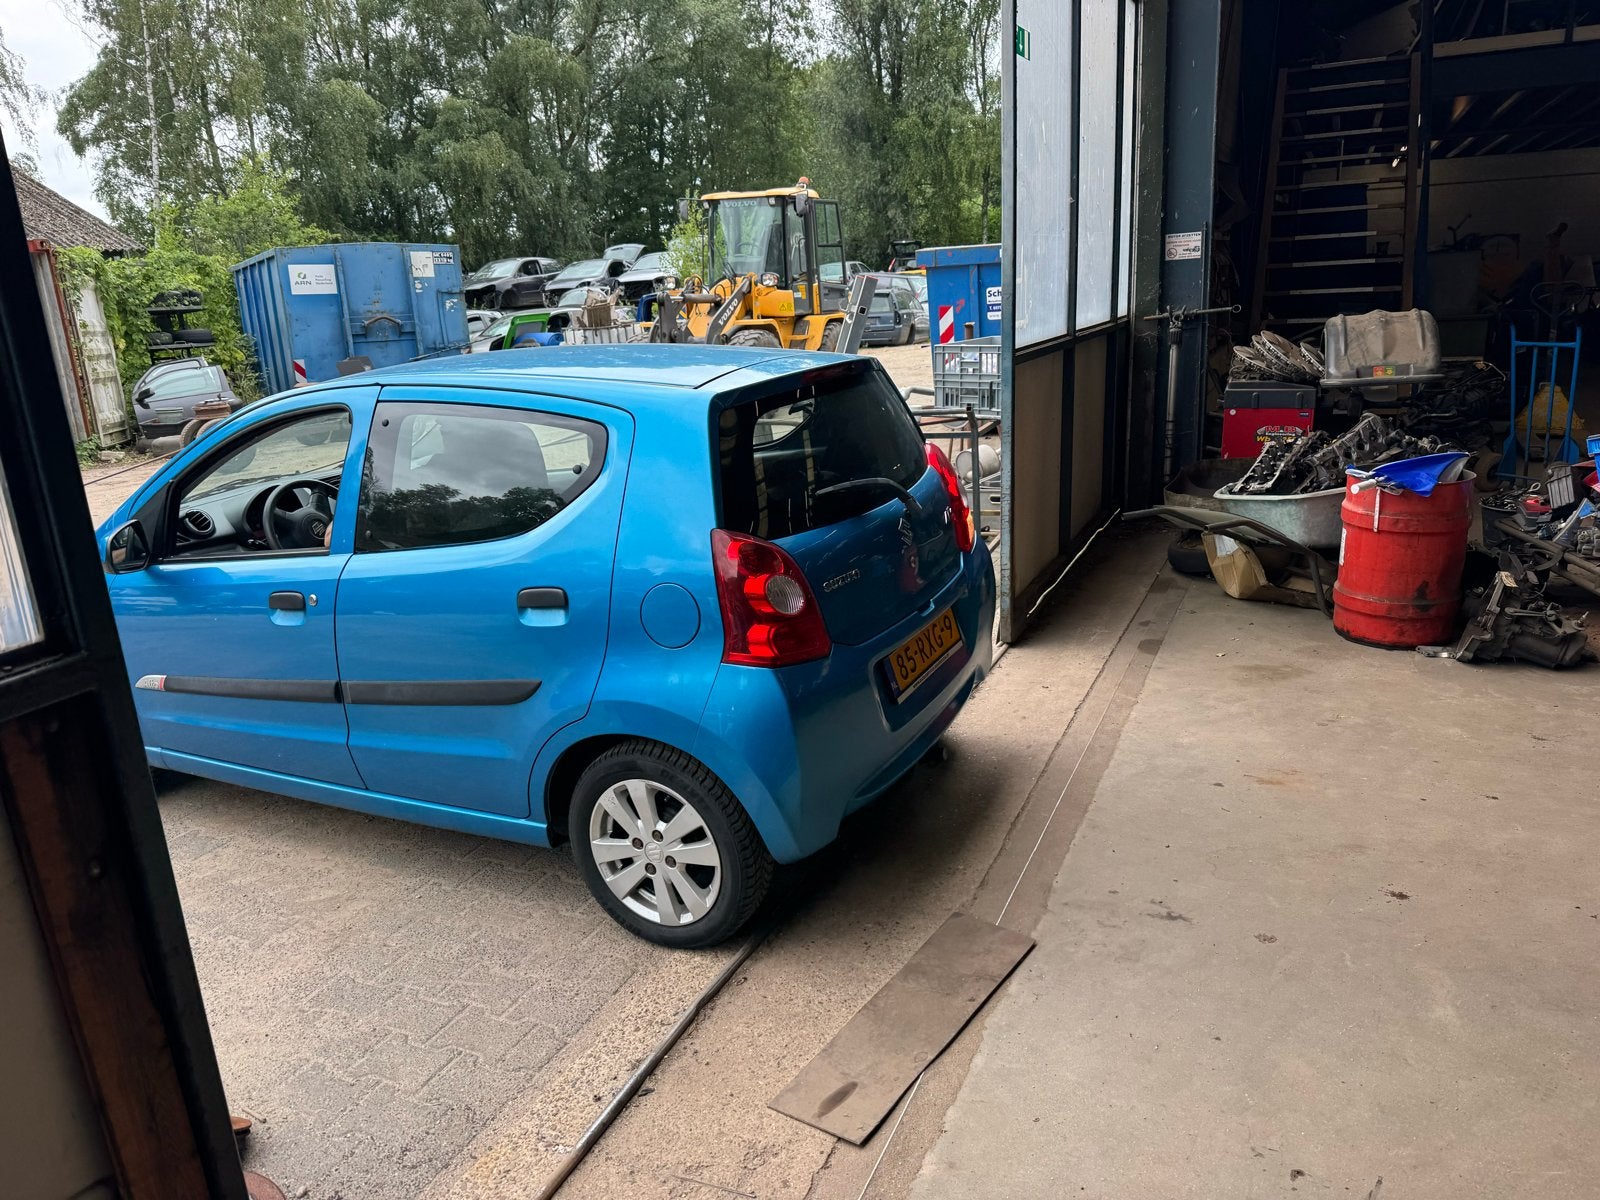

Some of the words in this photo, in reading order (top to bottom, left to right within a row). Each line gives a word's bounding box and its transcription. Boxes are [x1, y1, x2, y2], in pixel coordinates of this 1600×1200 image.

[724, 200, 757, 208] VOLVO
[718, 298, 738, 326] VOLVO
[822, 568, 861, 593] SUZUKI
[895, 614, 953, 681] 85-RXG-9
